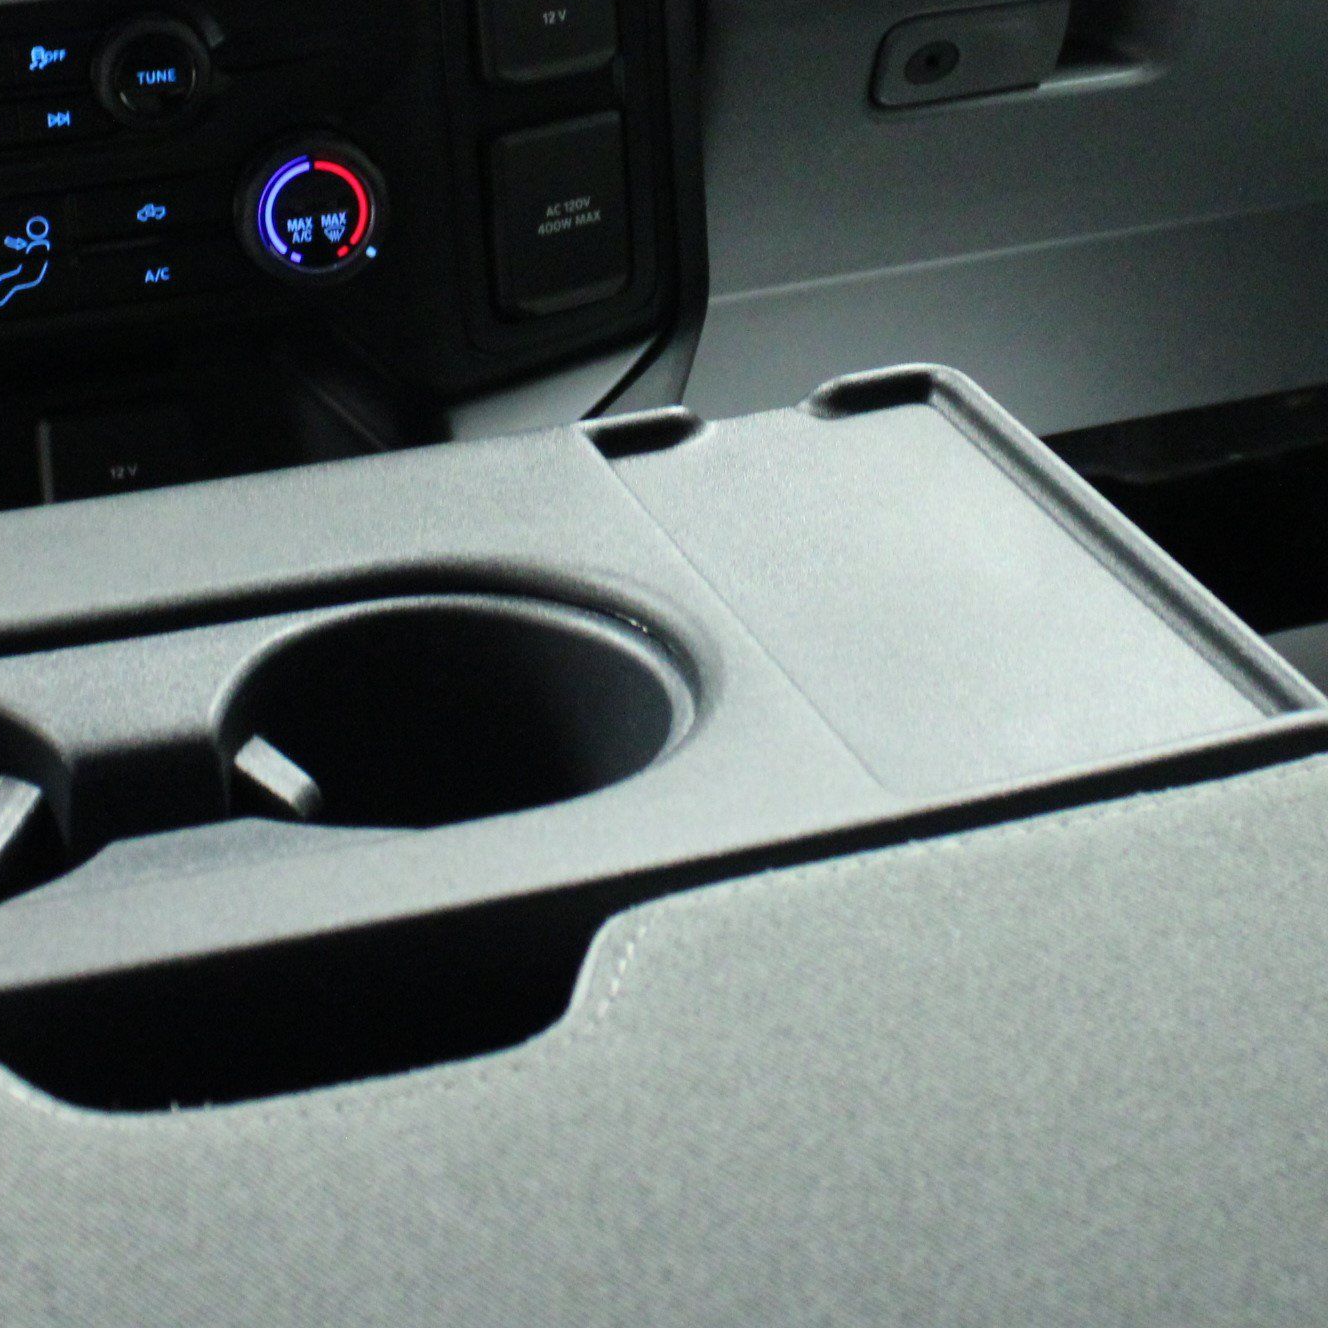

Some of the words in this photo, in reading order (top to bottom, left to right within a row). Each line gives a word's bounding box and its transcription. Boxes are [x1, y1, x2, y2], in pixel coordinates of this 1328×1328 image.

[137, 68, 176, 85] TUNE
[287, 217, 313, 232] MAX
[321, 212, 347, 226] MAX
[574, 211, 601, 226] MAX
[292, 231, 312, 244] A/C
[145, 266, 171, 283] A/C
